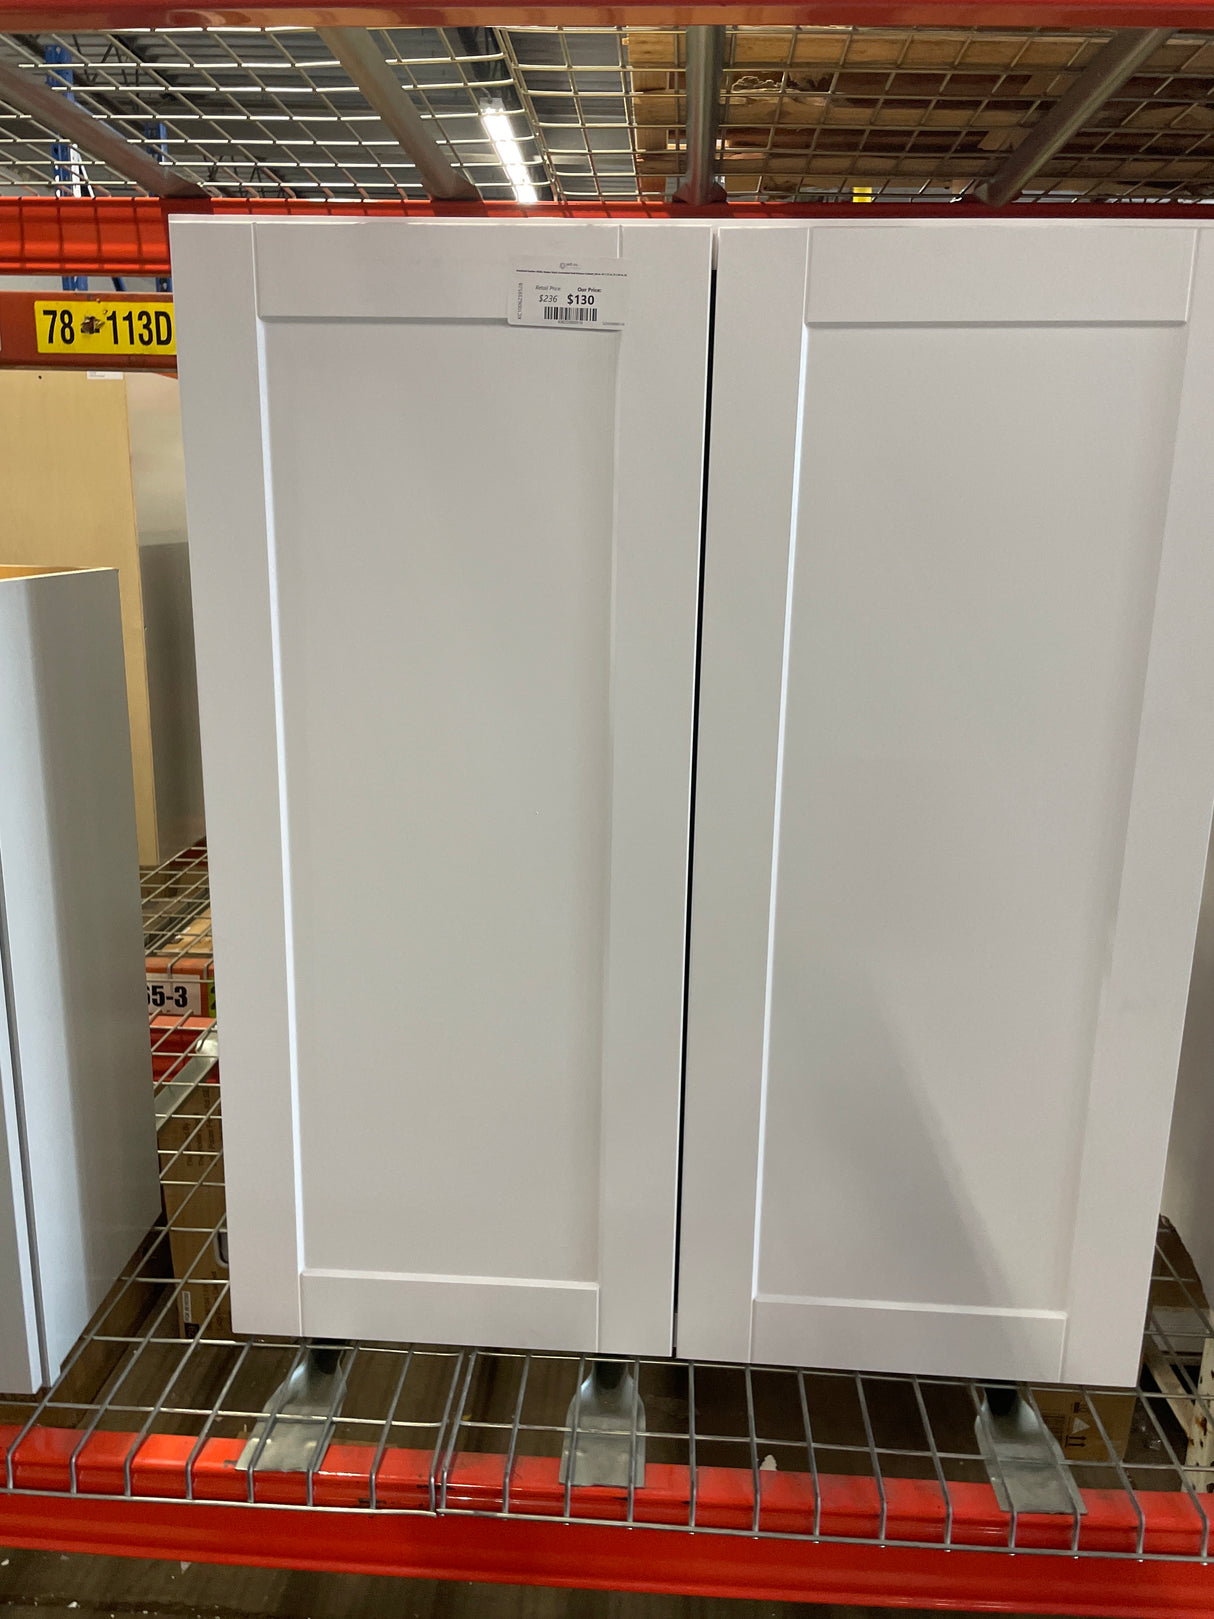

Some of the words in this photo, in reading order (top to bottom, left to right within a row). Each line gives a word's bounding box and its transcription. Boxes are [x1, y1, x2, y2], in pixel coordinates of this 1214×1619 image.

[538, 294, 558, 303] $236
[567, 293, 595, 305] $130
[106, 310, 172, 346] 113D
[147, 985, 188, 1008] 5-3
